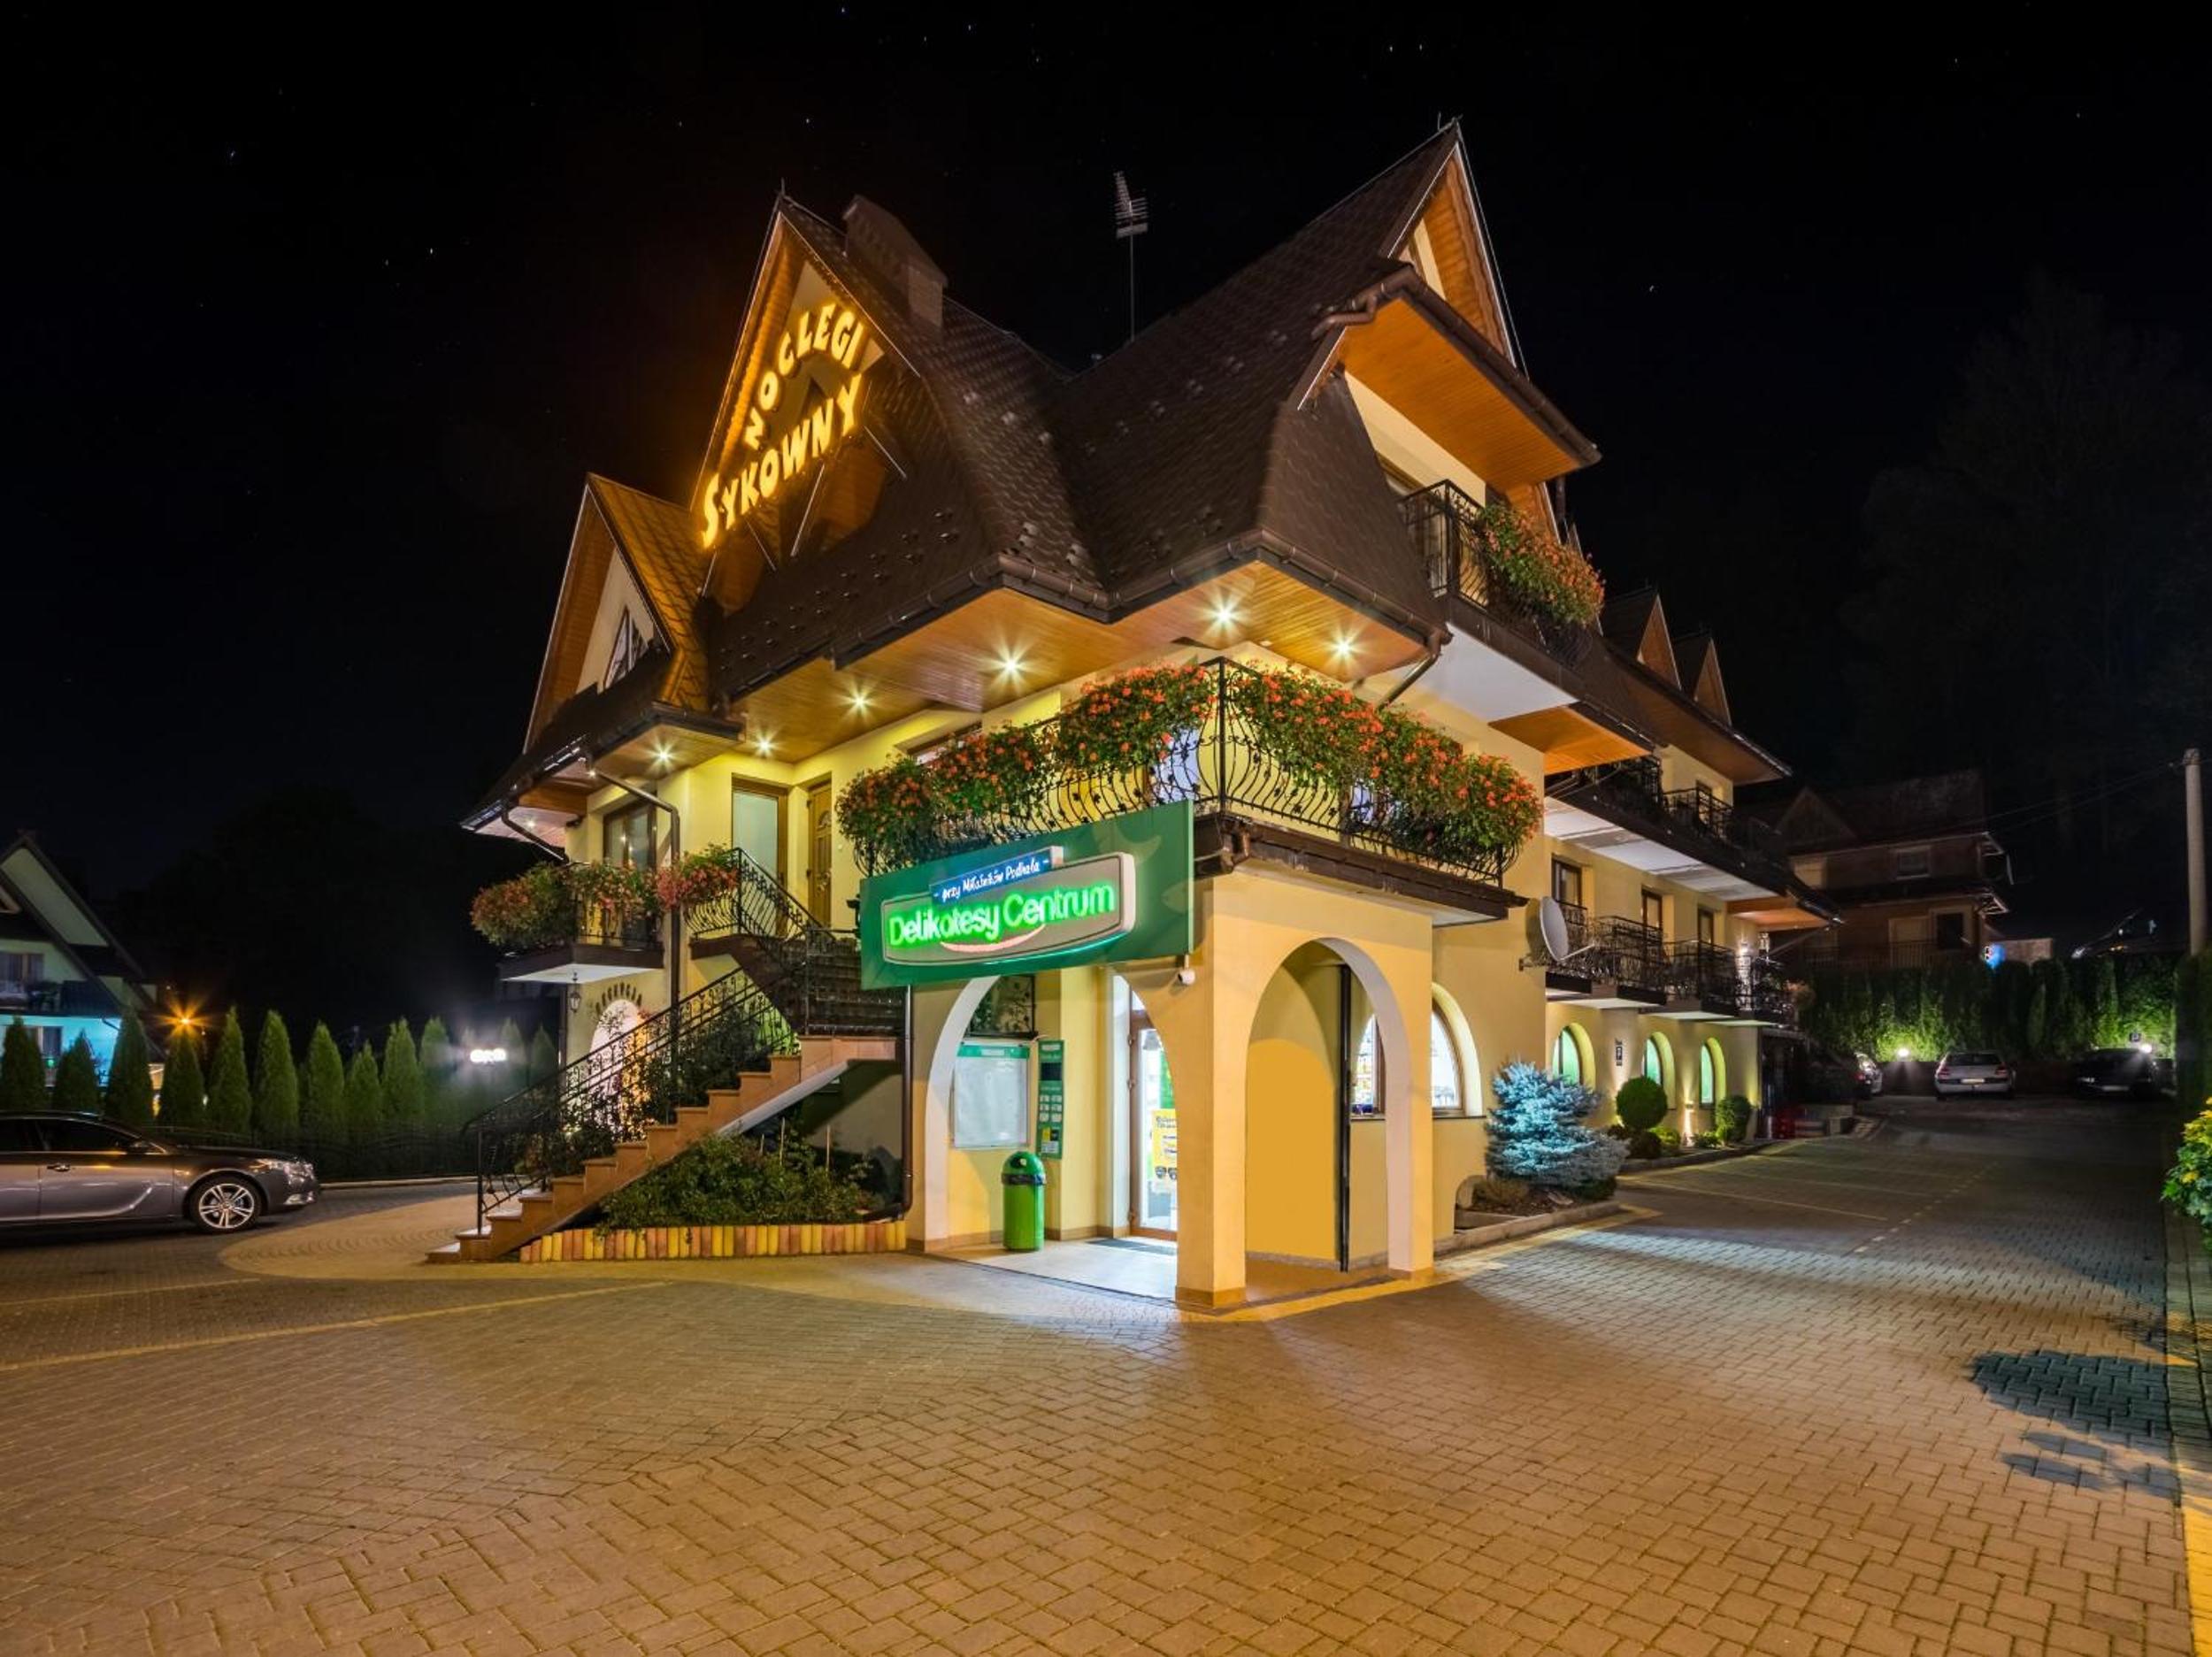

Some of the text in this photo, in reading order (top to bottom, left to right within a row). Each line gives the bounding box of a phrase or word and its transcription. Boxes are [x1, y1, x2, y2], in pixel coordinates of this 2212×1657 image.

[744, 303, 864, 450] NOCLEGI
[702, 372, 863, 548] SYKOWNY
[889, 885, 1116, 946] Delikatesy Centrum
